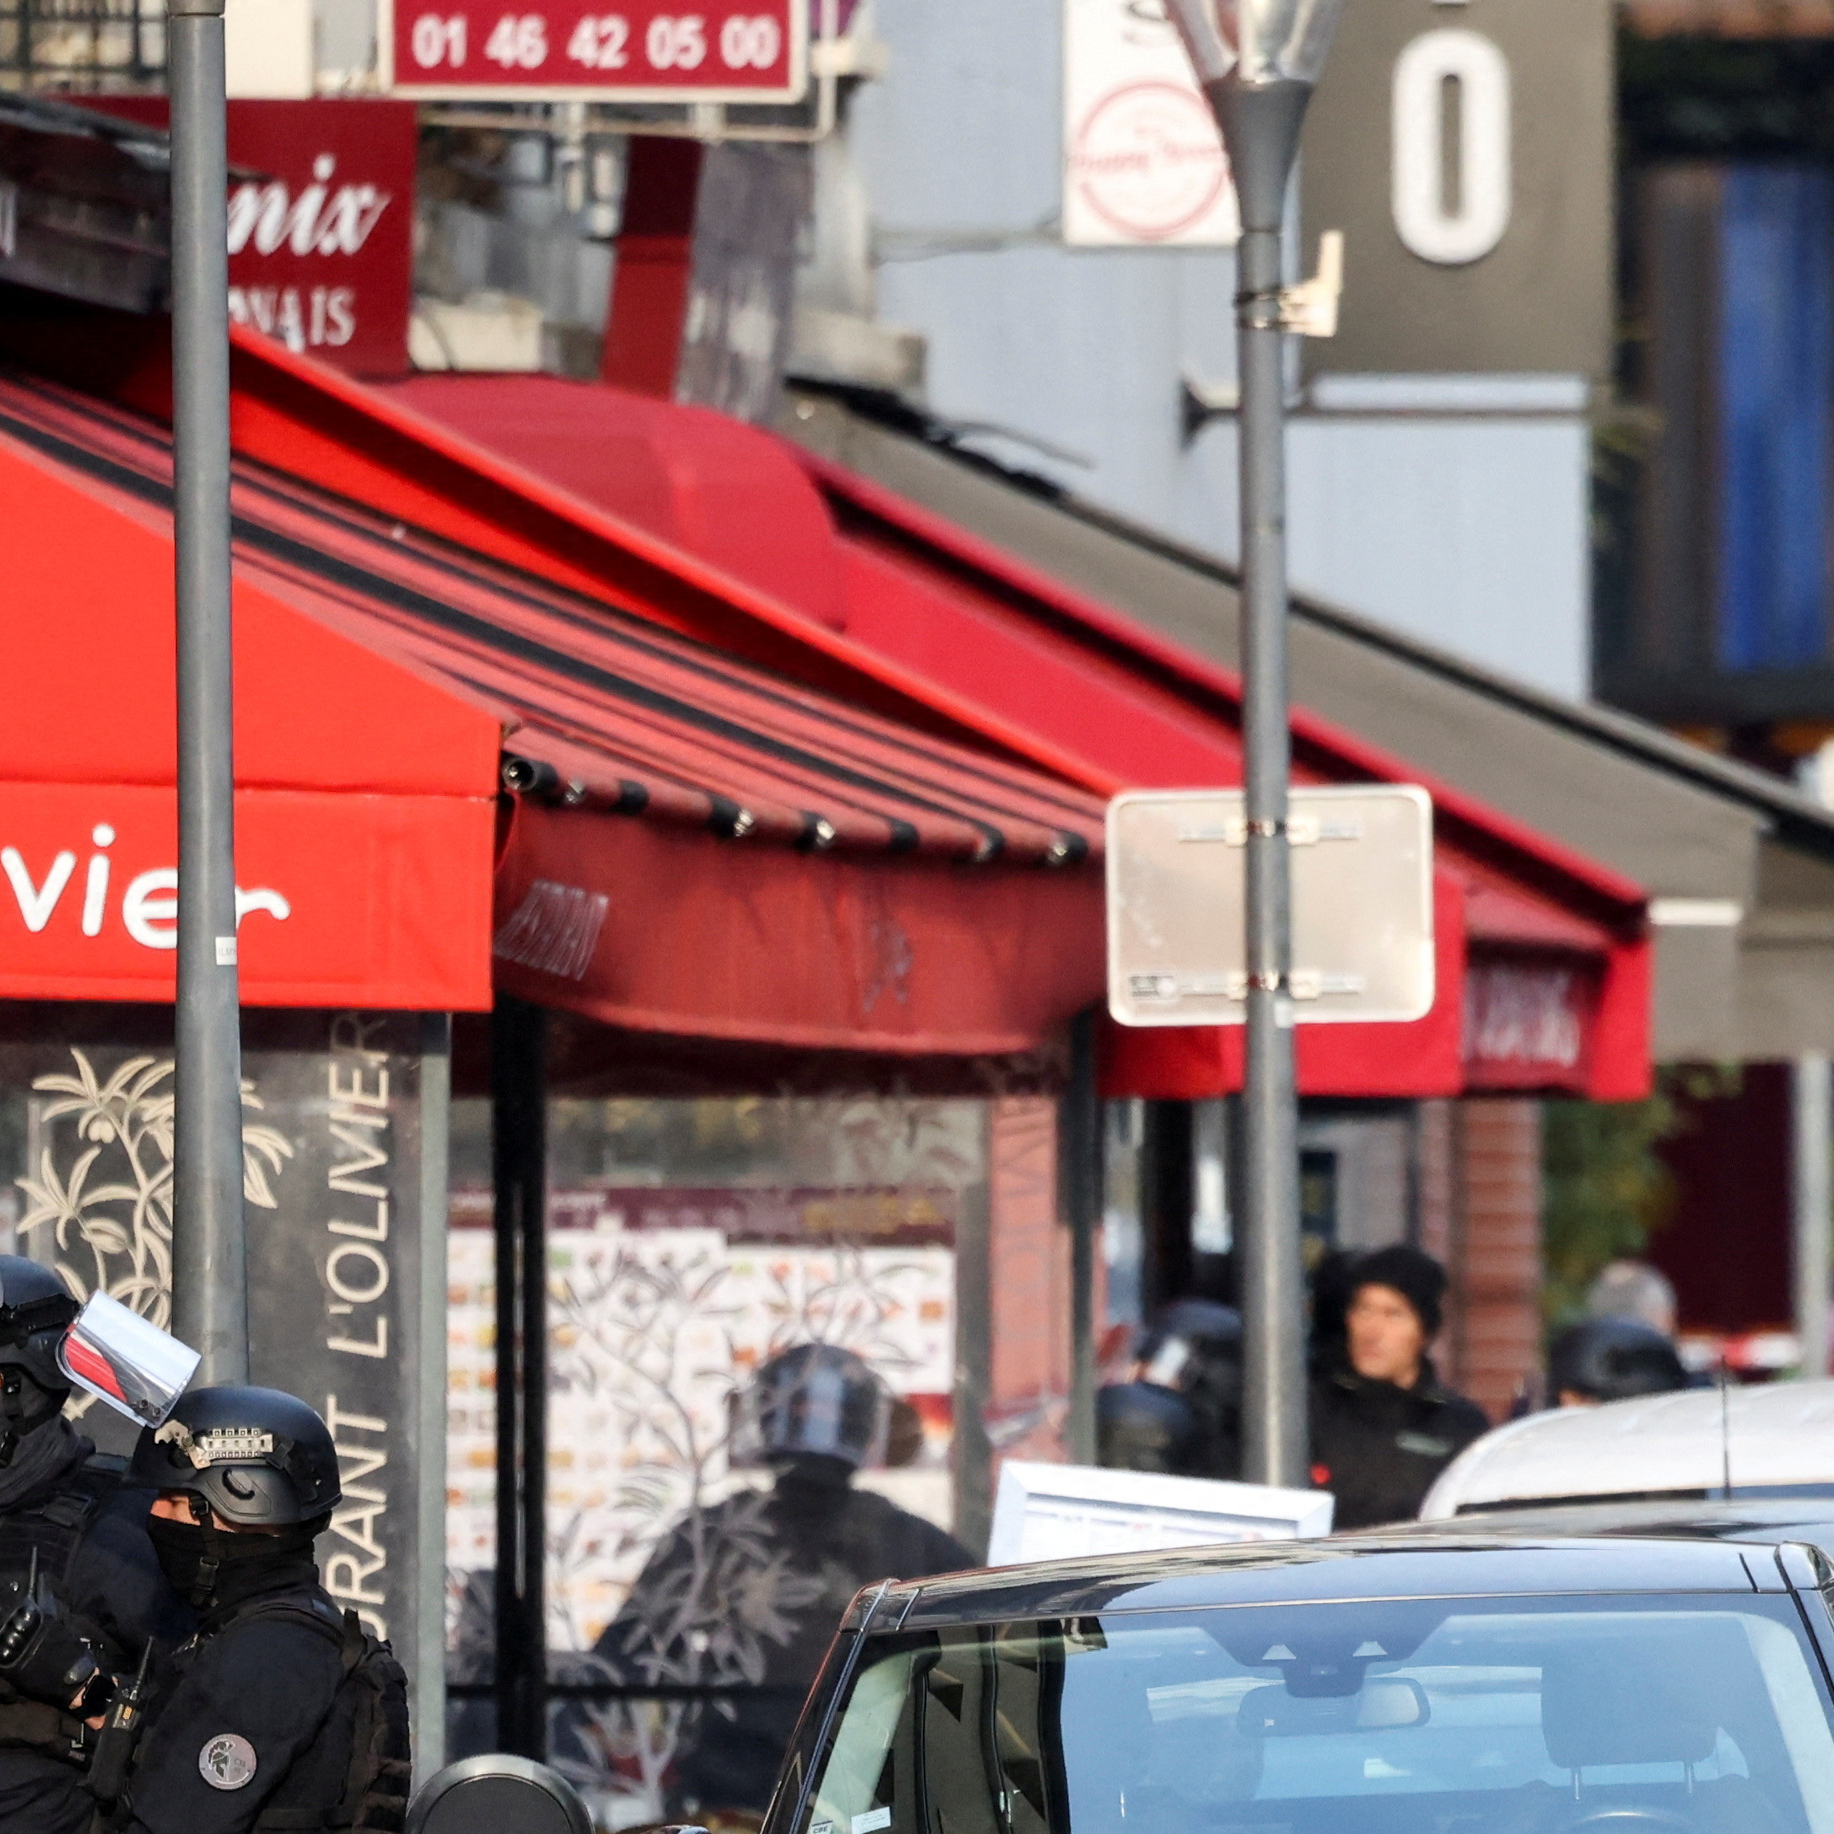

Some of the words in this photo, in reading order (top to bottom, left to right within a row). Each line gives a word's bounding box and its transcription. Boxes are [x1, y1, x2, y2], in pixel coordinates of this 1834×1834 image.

[411, 17, 468, 69] 01
[485, 17, 548, 69] 46
[567, 18, 629, 69] 42
[646, 16, 707, 69] 05
[719, 15, 780, 69] 00
[326, 1013, 390, 1358] L'OLIVIER
